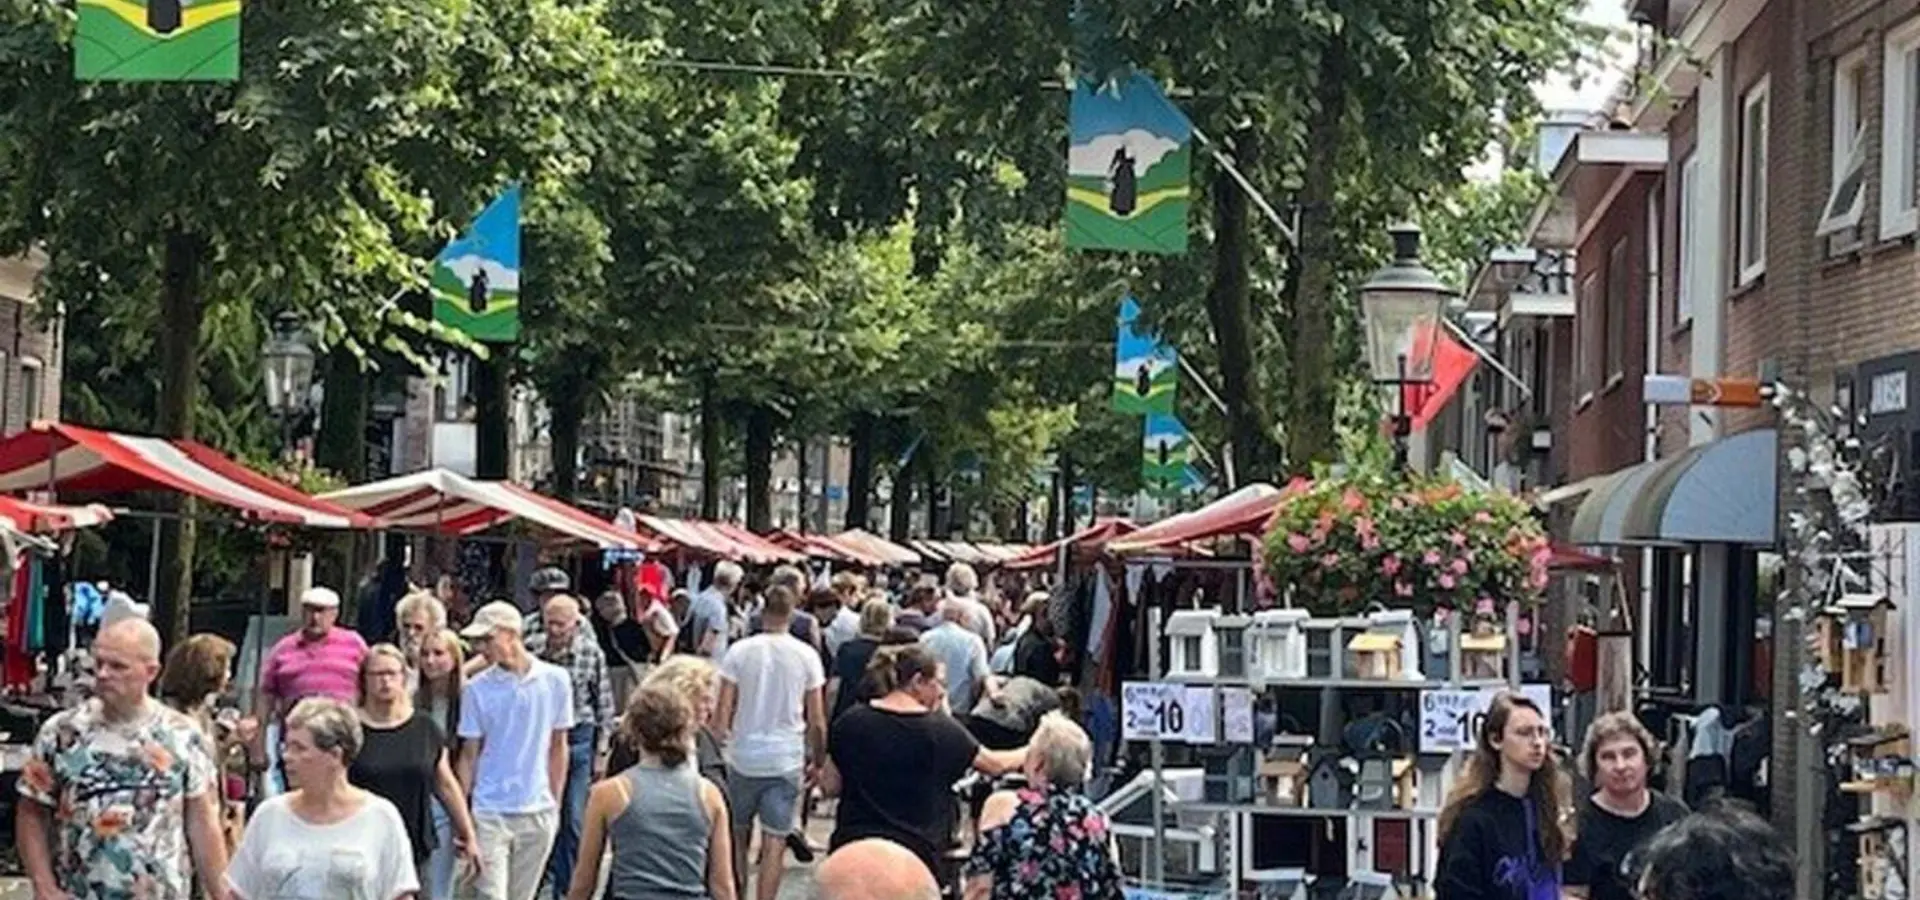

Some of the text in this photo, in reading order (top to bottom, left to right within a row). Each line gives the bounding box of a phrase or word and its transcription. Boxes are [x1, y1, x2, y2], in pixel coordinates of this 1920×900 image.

[1127, 710, 1137, 728] 2
[1154, 700, 1184, 733] 10
[1425, 719, 1436, 737] 2
